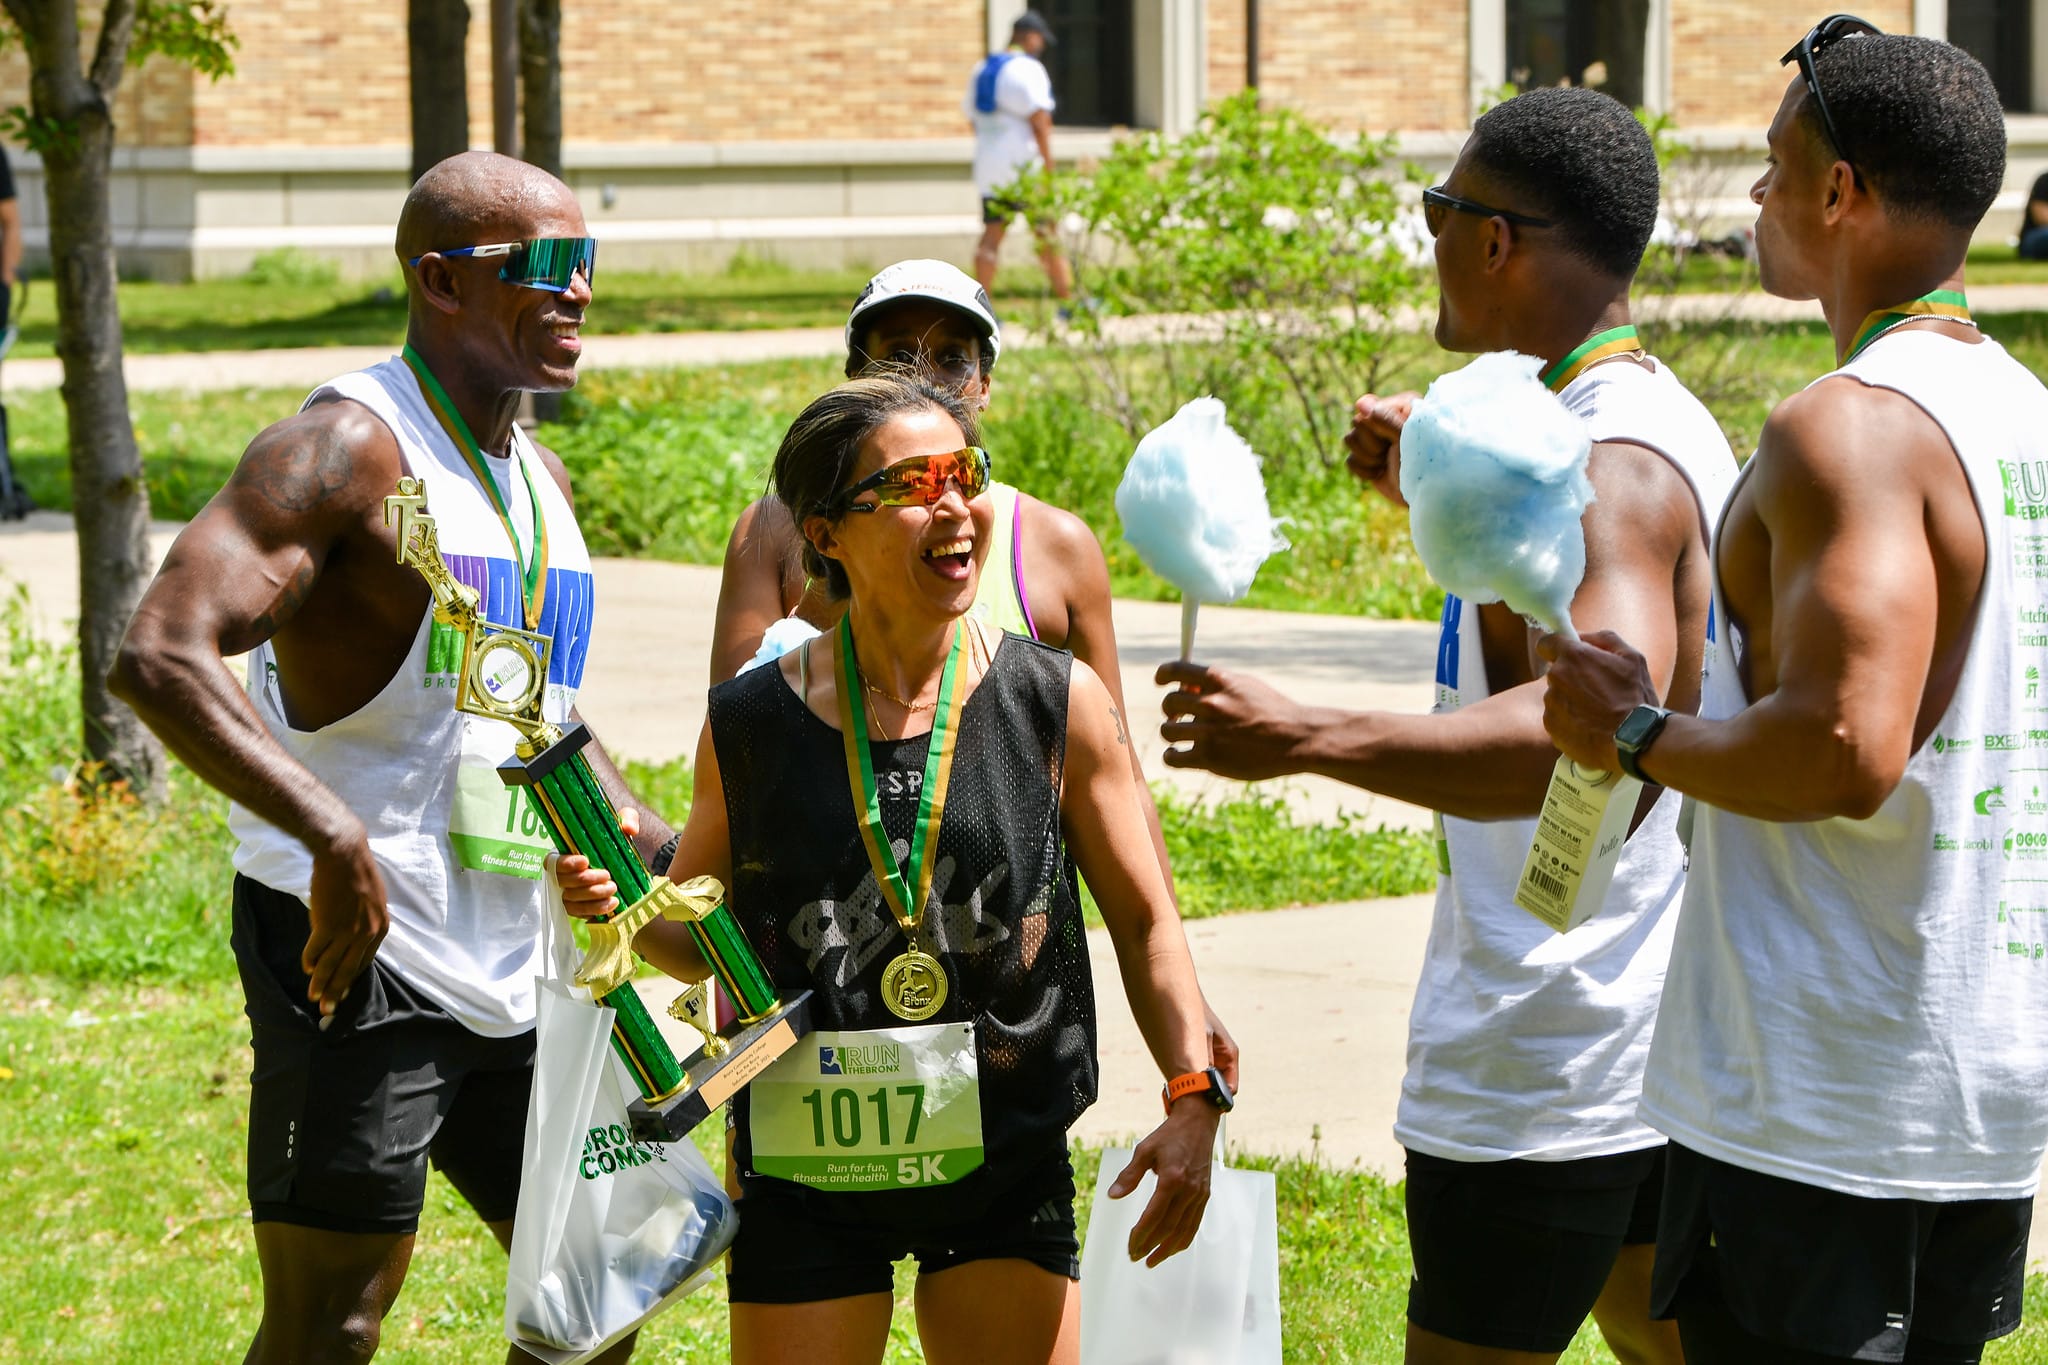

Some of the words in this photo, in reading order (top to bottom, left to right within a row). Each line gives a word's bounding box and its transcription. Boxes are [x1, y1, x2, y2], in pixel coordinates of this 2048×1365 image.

[2006, 461, 2048, 503] RU
[424, 677, 458, 689] BRO
[505, 785, 548, 839] 18
[481, 854, 507, 867] fitness
[507, 860, 522, 869] and
[508, 849, 523, 859] Run
[522, 851, 533, 861] for
[847, 1044, 900, 1067] RUN
[847, 1064, 900, 1075] THEBRONX
[802, 1084, 925, 1148] 1017
[582, 1122, 634, 1156] BRO
[792, 1173, 828, 1183] fitness
[830, 1173, 849, 1183] and
[851, 1172, 889, 1183] health!
[827, 1163, 848, 1173] Run
[850, 1163, 866, 1173] for
[896, 1154, 947, 1185] 5K
